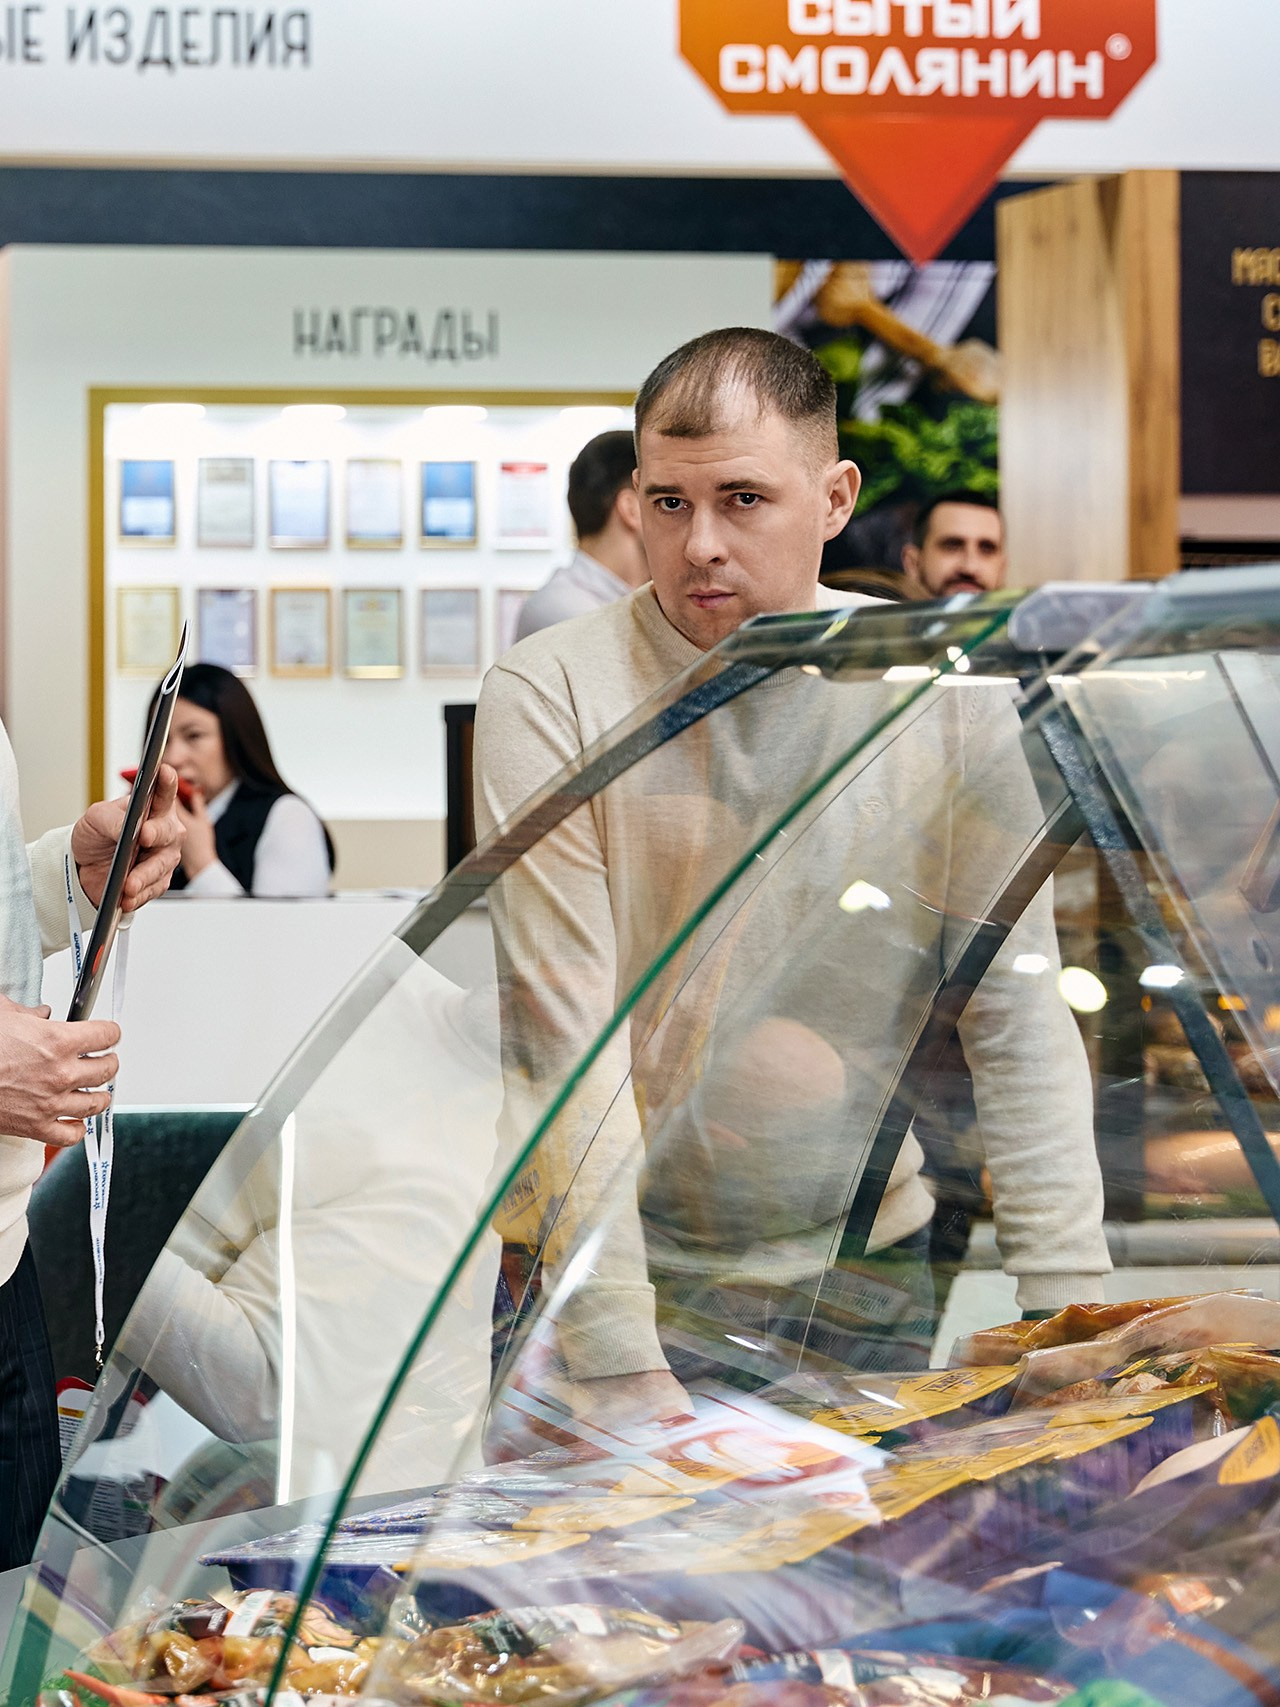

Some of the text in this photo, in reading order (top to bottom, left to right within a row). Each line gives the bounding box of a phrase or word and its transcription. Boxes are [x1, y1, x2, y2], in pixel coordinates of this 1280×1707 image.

[65, 6, 312, 75] ИЗДЕЛИЯ
[719, 43, 1104, 99] СМОЛЯНИН
[292, 306, 500, 366] НАГРАДЫ
